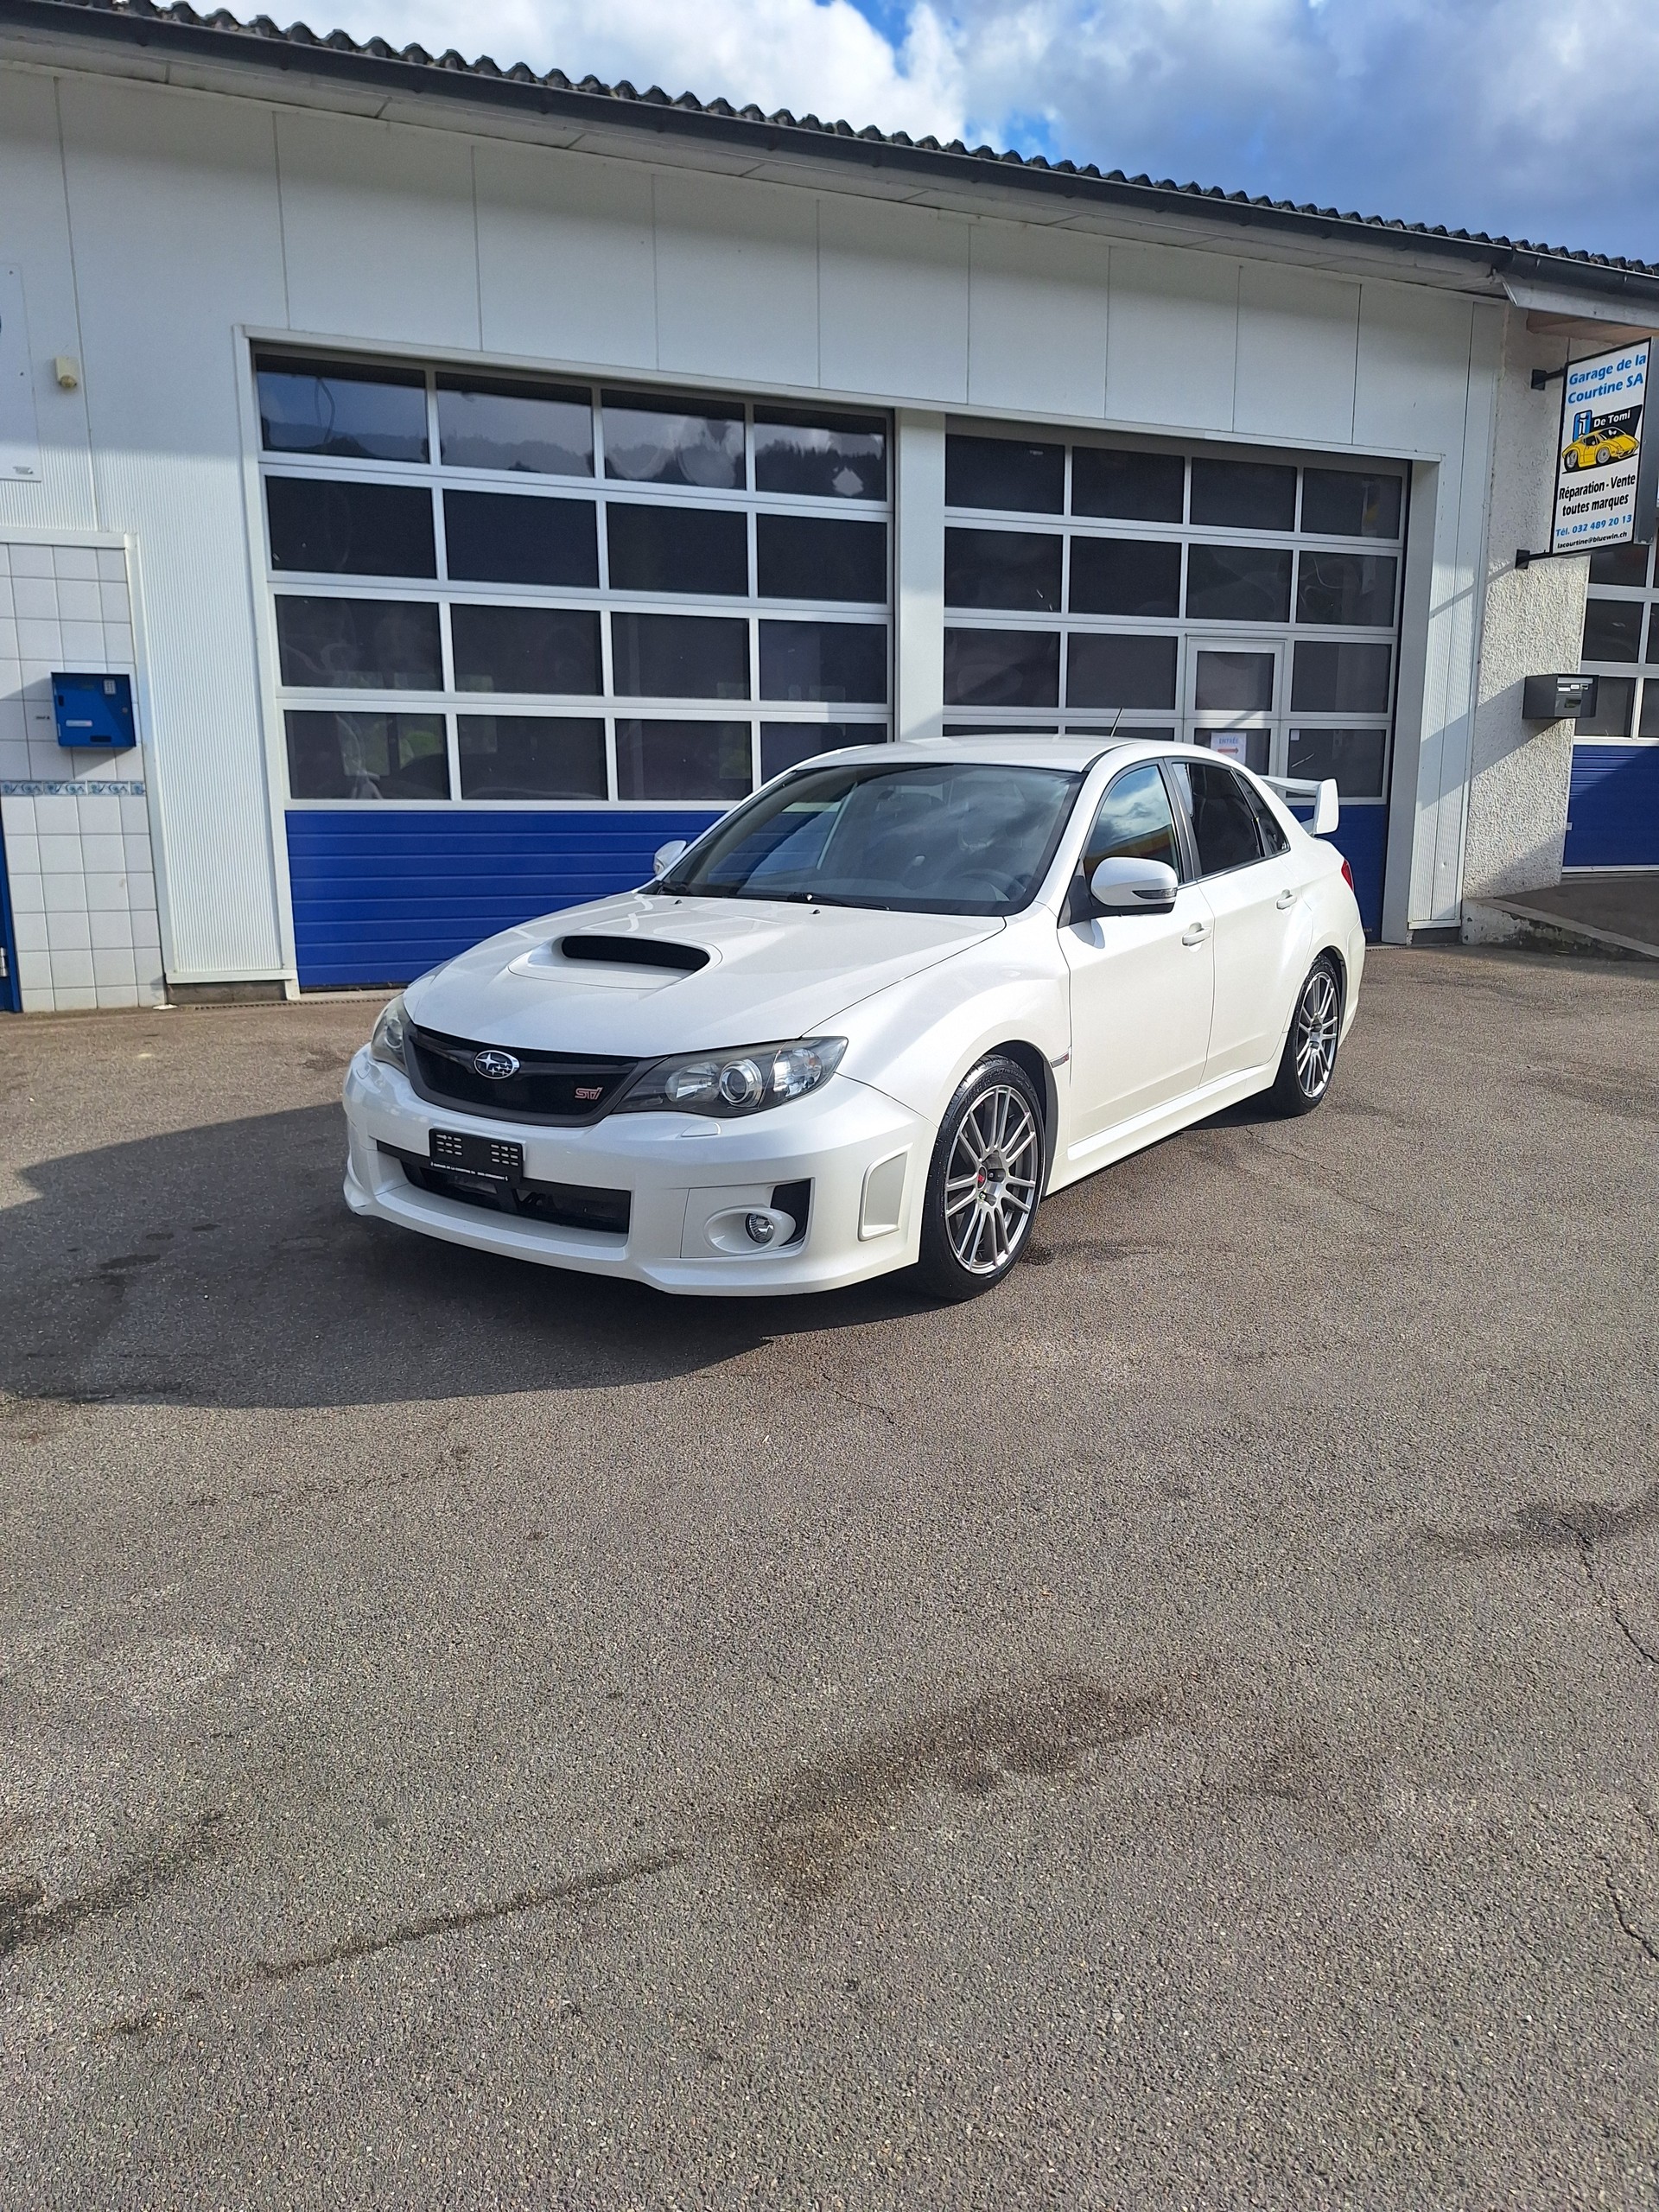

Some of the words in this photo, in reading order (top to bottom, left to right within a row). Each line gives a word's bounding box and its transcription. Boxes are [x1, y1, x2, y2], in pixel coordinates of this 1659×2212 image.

[1569, 365, 1613, 385] Garage
[1617, 359, 1632, 372] de
[1635, 354, 1646, 366] la
[1567, 380, 1623, 404] Courtine
[1626, 372, 1643, 388] SA
[1593, 418, 1606, 428] De
[1608, 410, 1630, 424] Tomi
[1559, 480, 1605, 501] Réparation
[1611, 474, 1636, 489] Vente
[1562, 502, 1589, 517] toutes
[1591, 493, 1629, 511] marques
[1556, 527, 1570, 537] Tél.
[1572, 524, 1588, 534] 032
[1590, 520, 1606, 531] 489
[1608, 517, 1619, 527] 20
[1622, 514, 1632, 524] 13
[1557, 531, 1627, 549] lacourtine@bluewin.ch
